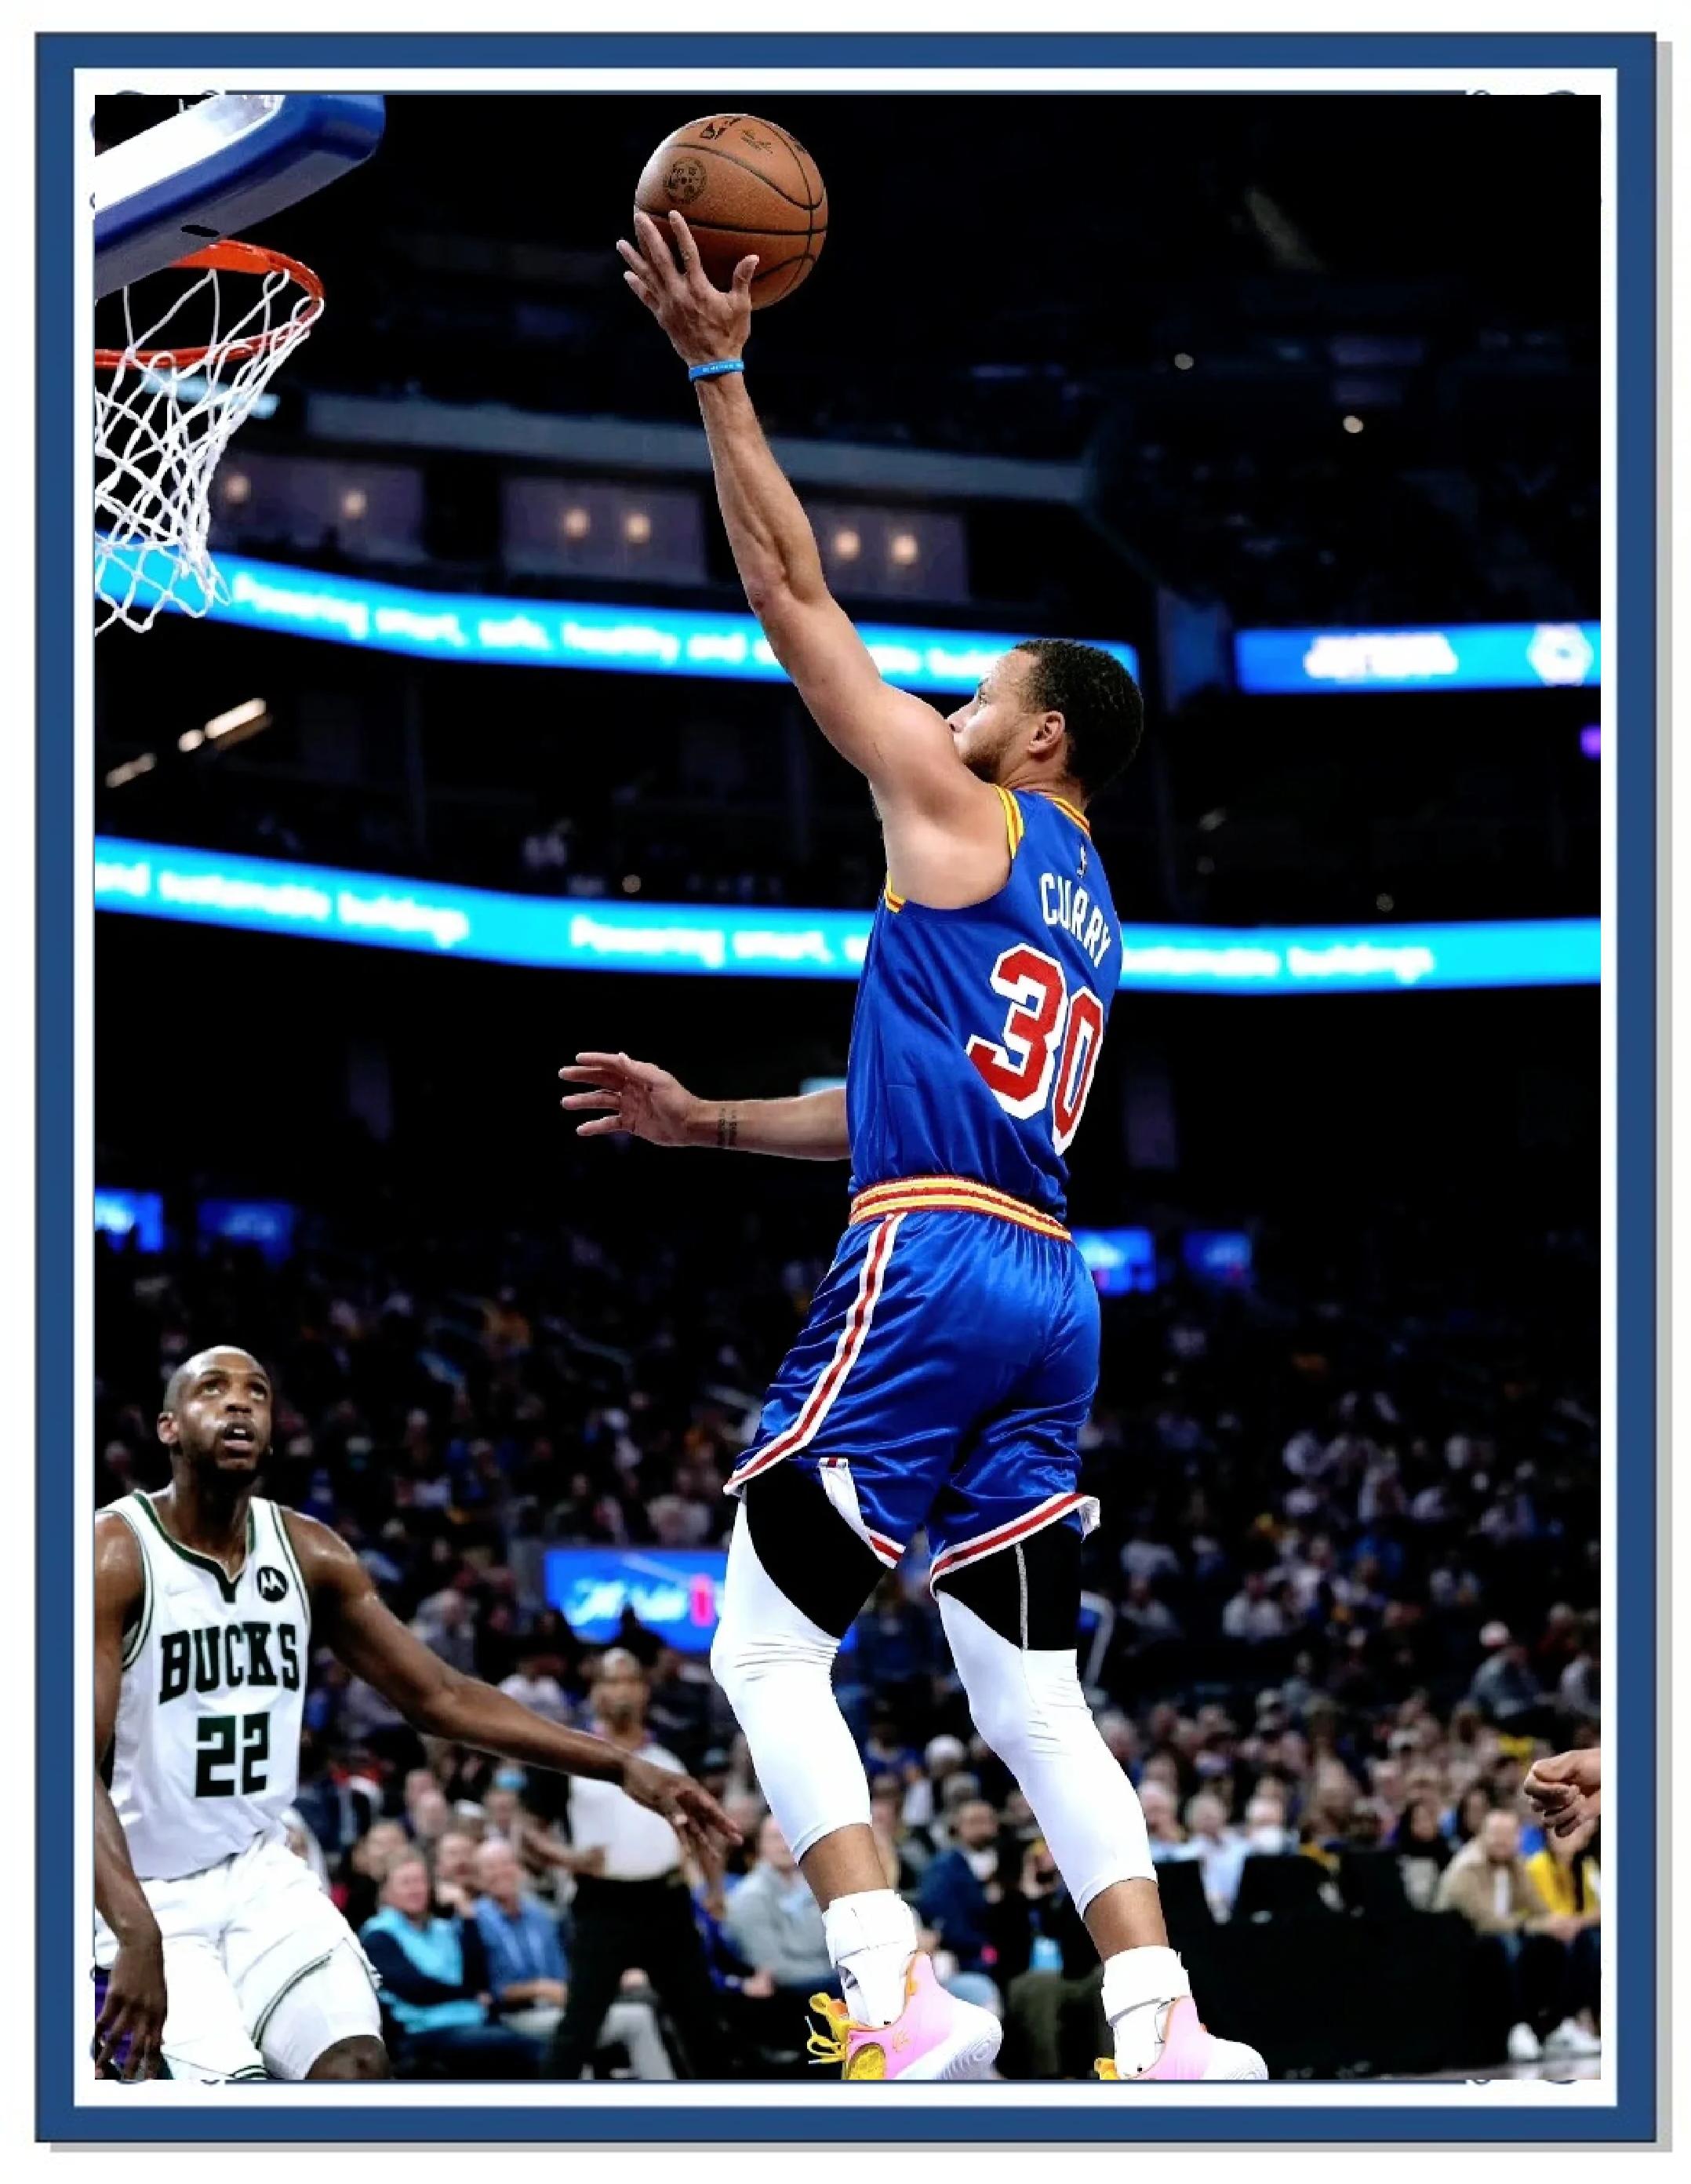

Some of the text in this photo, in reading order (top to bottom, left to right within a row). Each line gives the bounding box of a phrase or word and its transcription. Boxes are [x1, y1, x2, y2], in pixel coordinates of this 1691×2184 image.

[686, 632, 749, 664] and
[1040, 872, 1112, 968] CURRY
[966, 942, 1104, 1156] 30
[158, 1621, 300, 1705] BUCKS
[195, 1713, 271, 1798] 22
